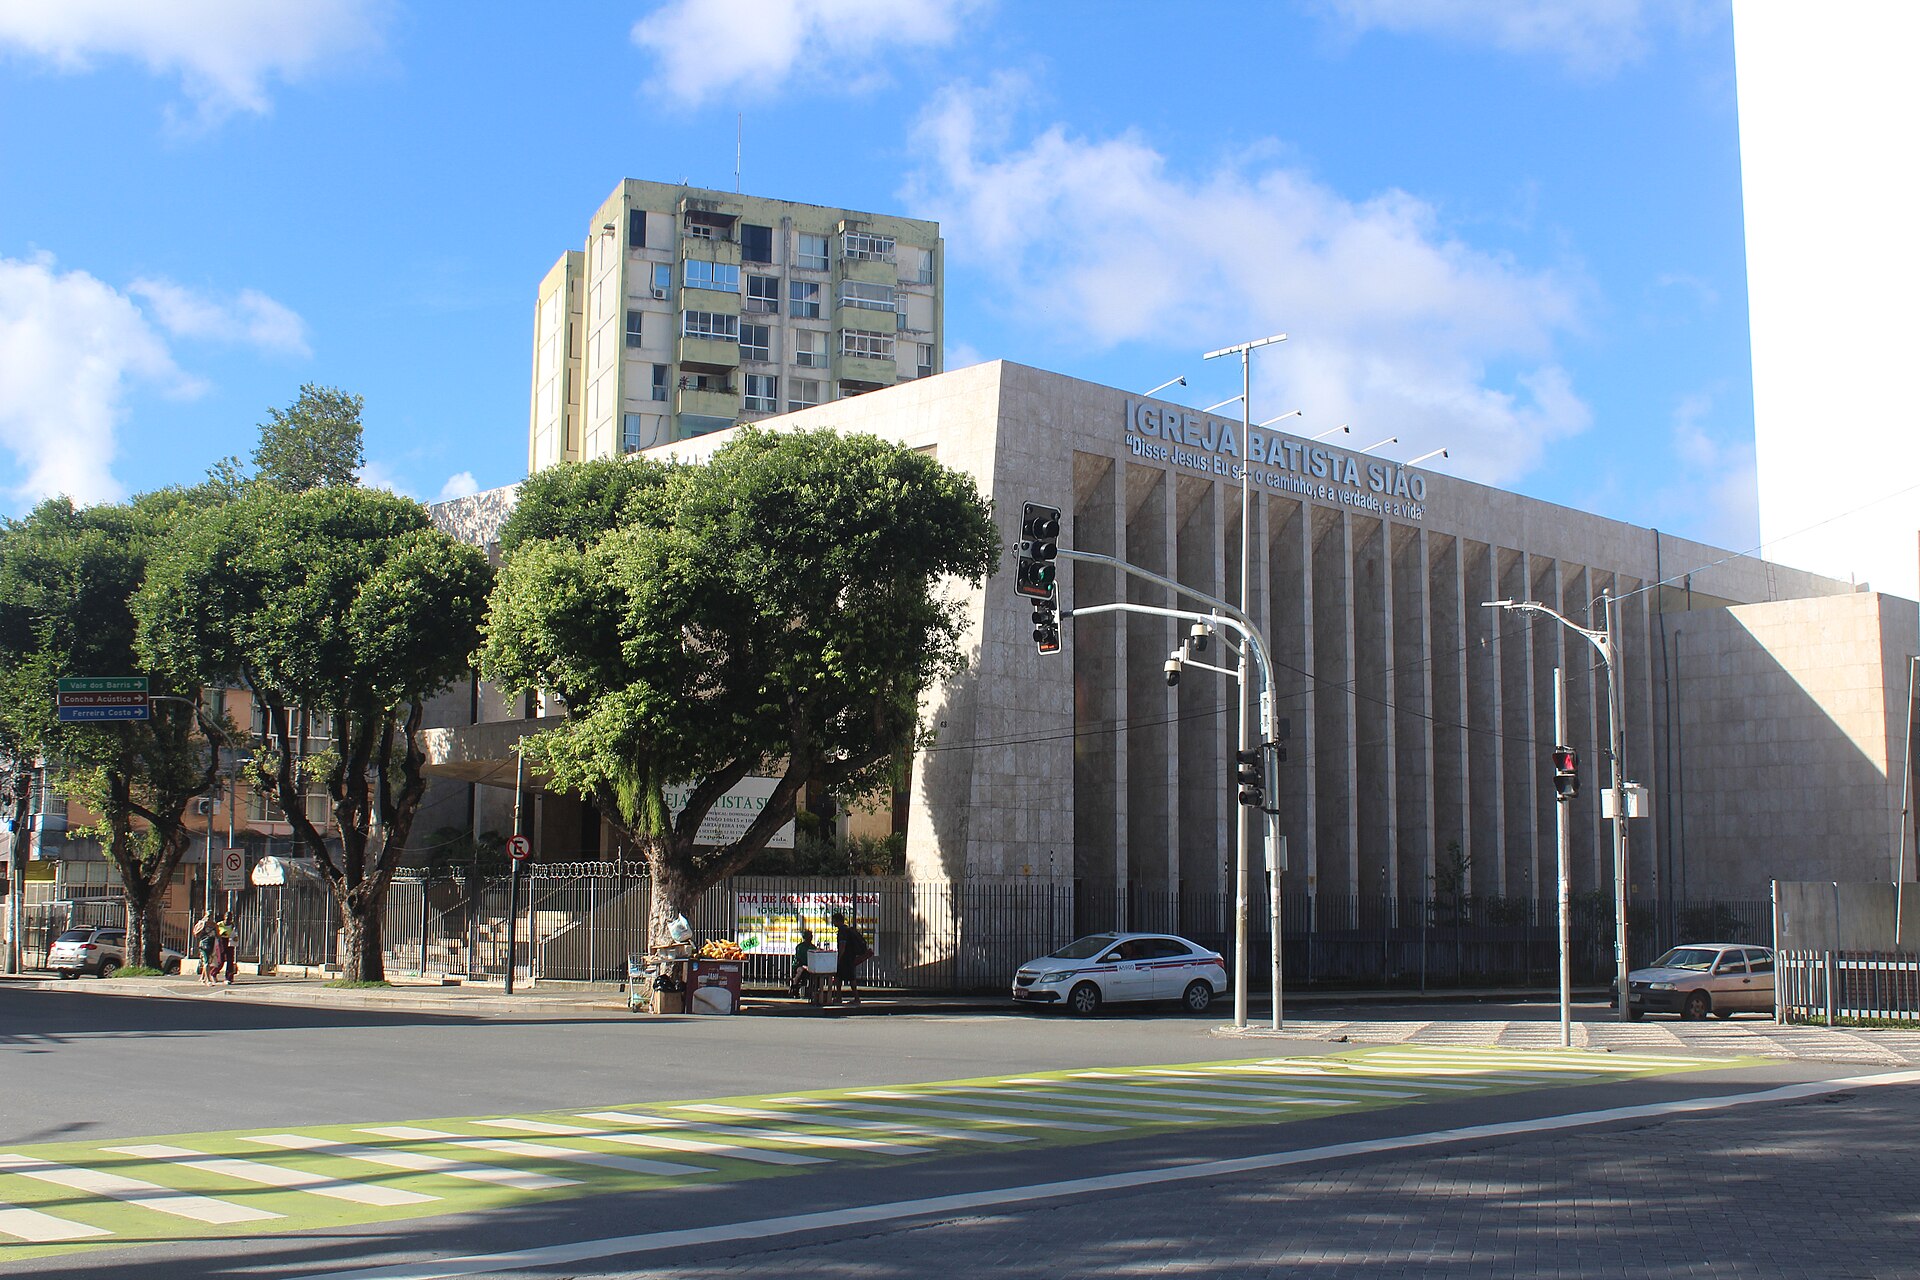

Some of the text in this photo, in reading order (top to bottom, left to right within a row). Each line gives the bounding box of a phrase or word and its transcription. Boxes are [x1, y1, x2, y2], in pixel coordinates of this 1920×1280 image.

[1125, 399, 1427, 501] IGREJA BATISTA SIÃO
[1170, 445, 1211, 471] Jesus:
[1213, 455, 1229, 476] Eu
[1255, 471, 1263, 483] o
[1266, 471, 1316, 500] caminho,
[1317, 484, 1325, 497] e
[1326, 487, 1334, 500] a
[1337, 488, 1382, 515] verdade,
[1383, 501, 1391, 513] e
[1392, 503, 1400, 516] a
[96, 694, 132, 703] Acústica
[106, 681, 131, 689] Barris
